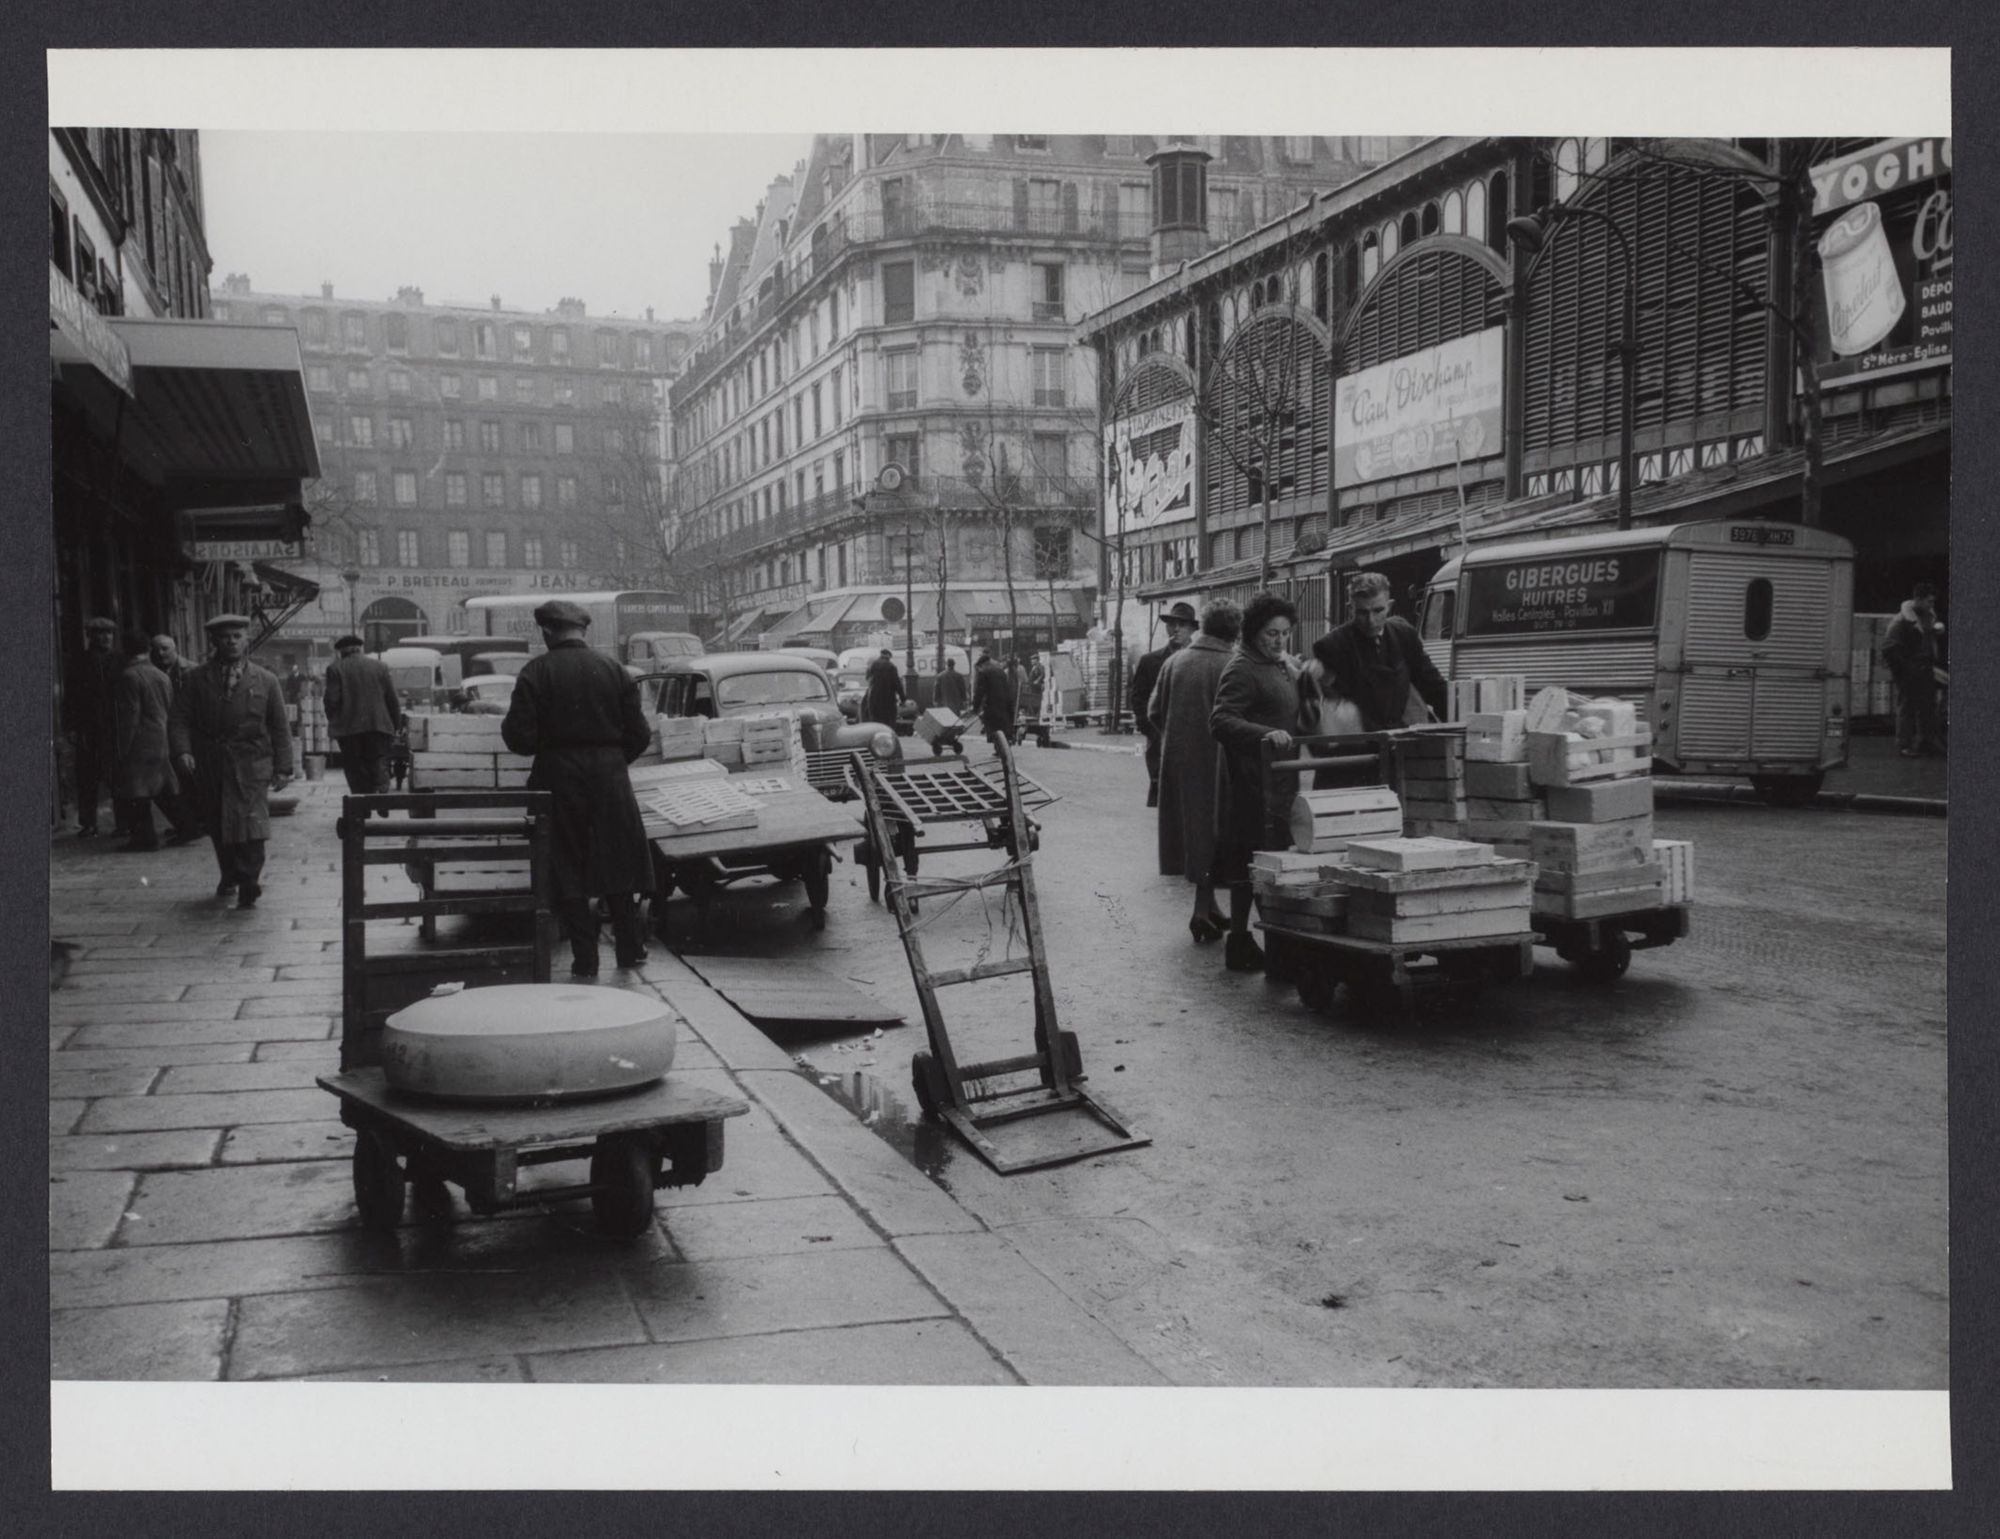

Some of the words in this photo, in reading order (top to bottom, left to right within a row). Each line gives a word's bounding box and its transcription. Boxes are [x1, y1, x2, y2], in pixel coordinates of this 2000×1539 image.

[403, 575, 469, 587] BRETEAU
[529, 574, 576, 588] JEAN
[1506, 560, 1619, 590] GIBERGUES
[1522, 587, 1588, 606] HUITRES
